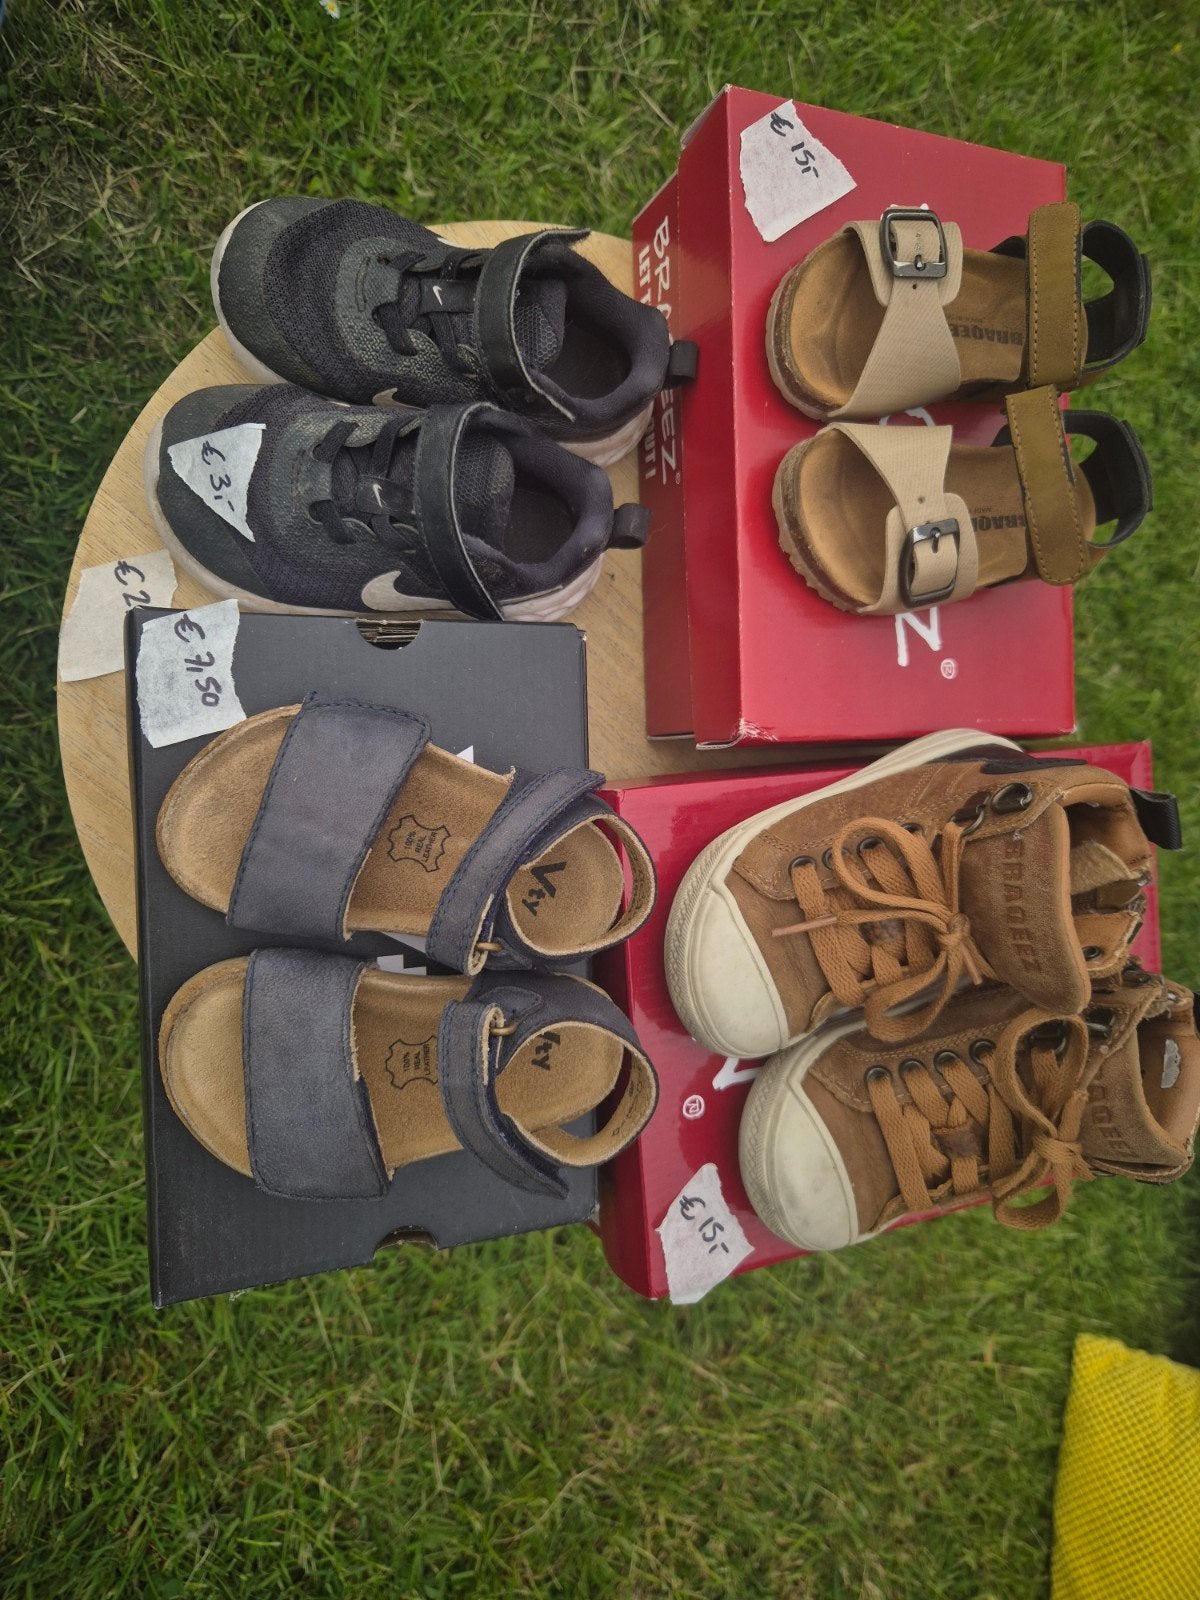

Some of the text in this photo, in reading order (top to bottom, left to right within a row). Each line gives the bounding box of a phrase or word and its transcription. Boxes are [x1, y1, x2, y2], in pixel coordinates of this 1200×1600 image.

[638, 245, 651, 287] LET
[414, 834, 426, 854] REAL
[423, 830, 438, 863] LEATHER
